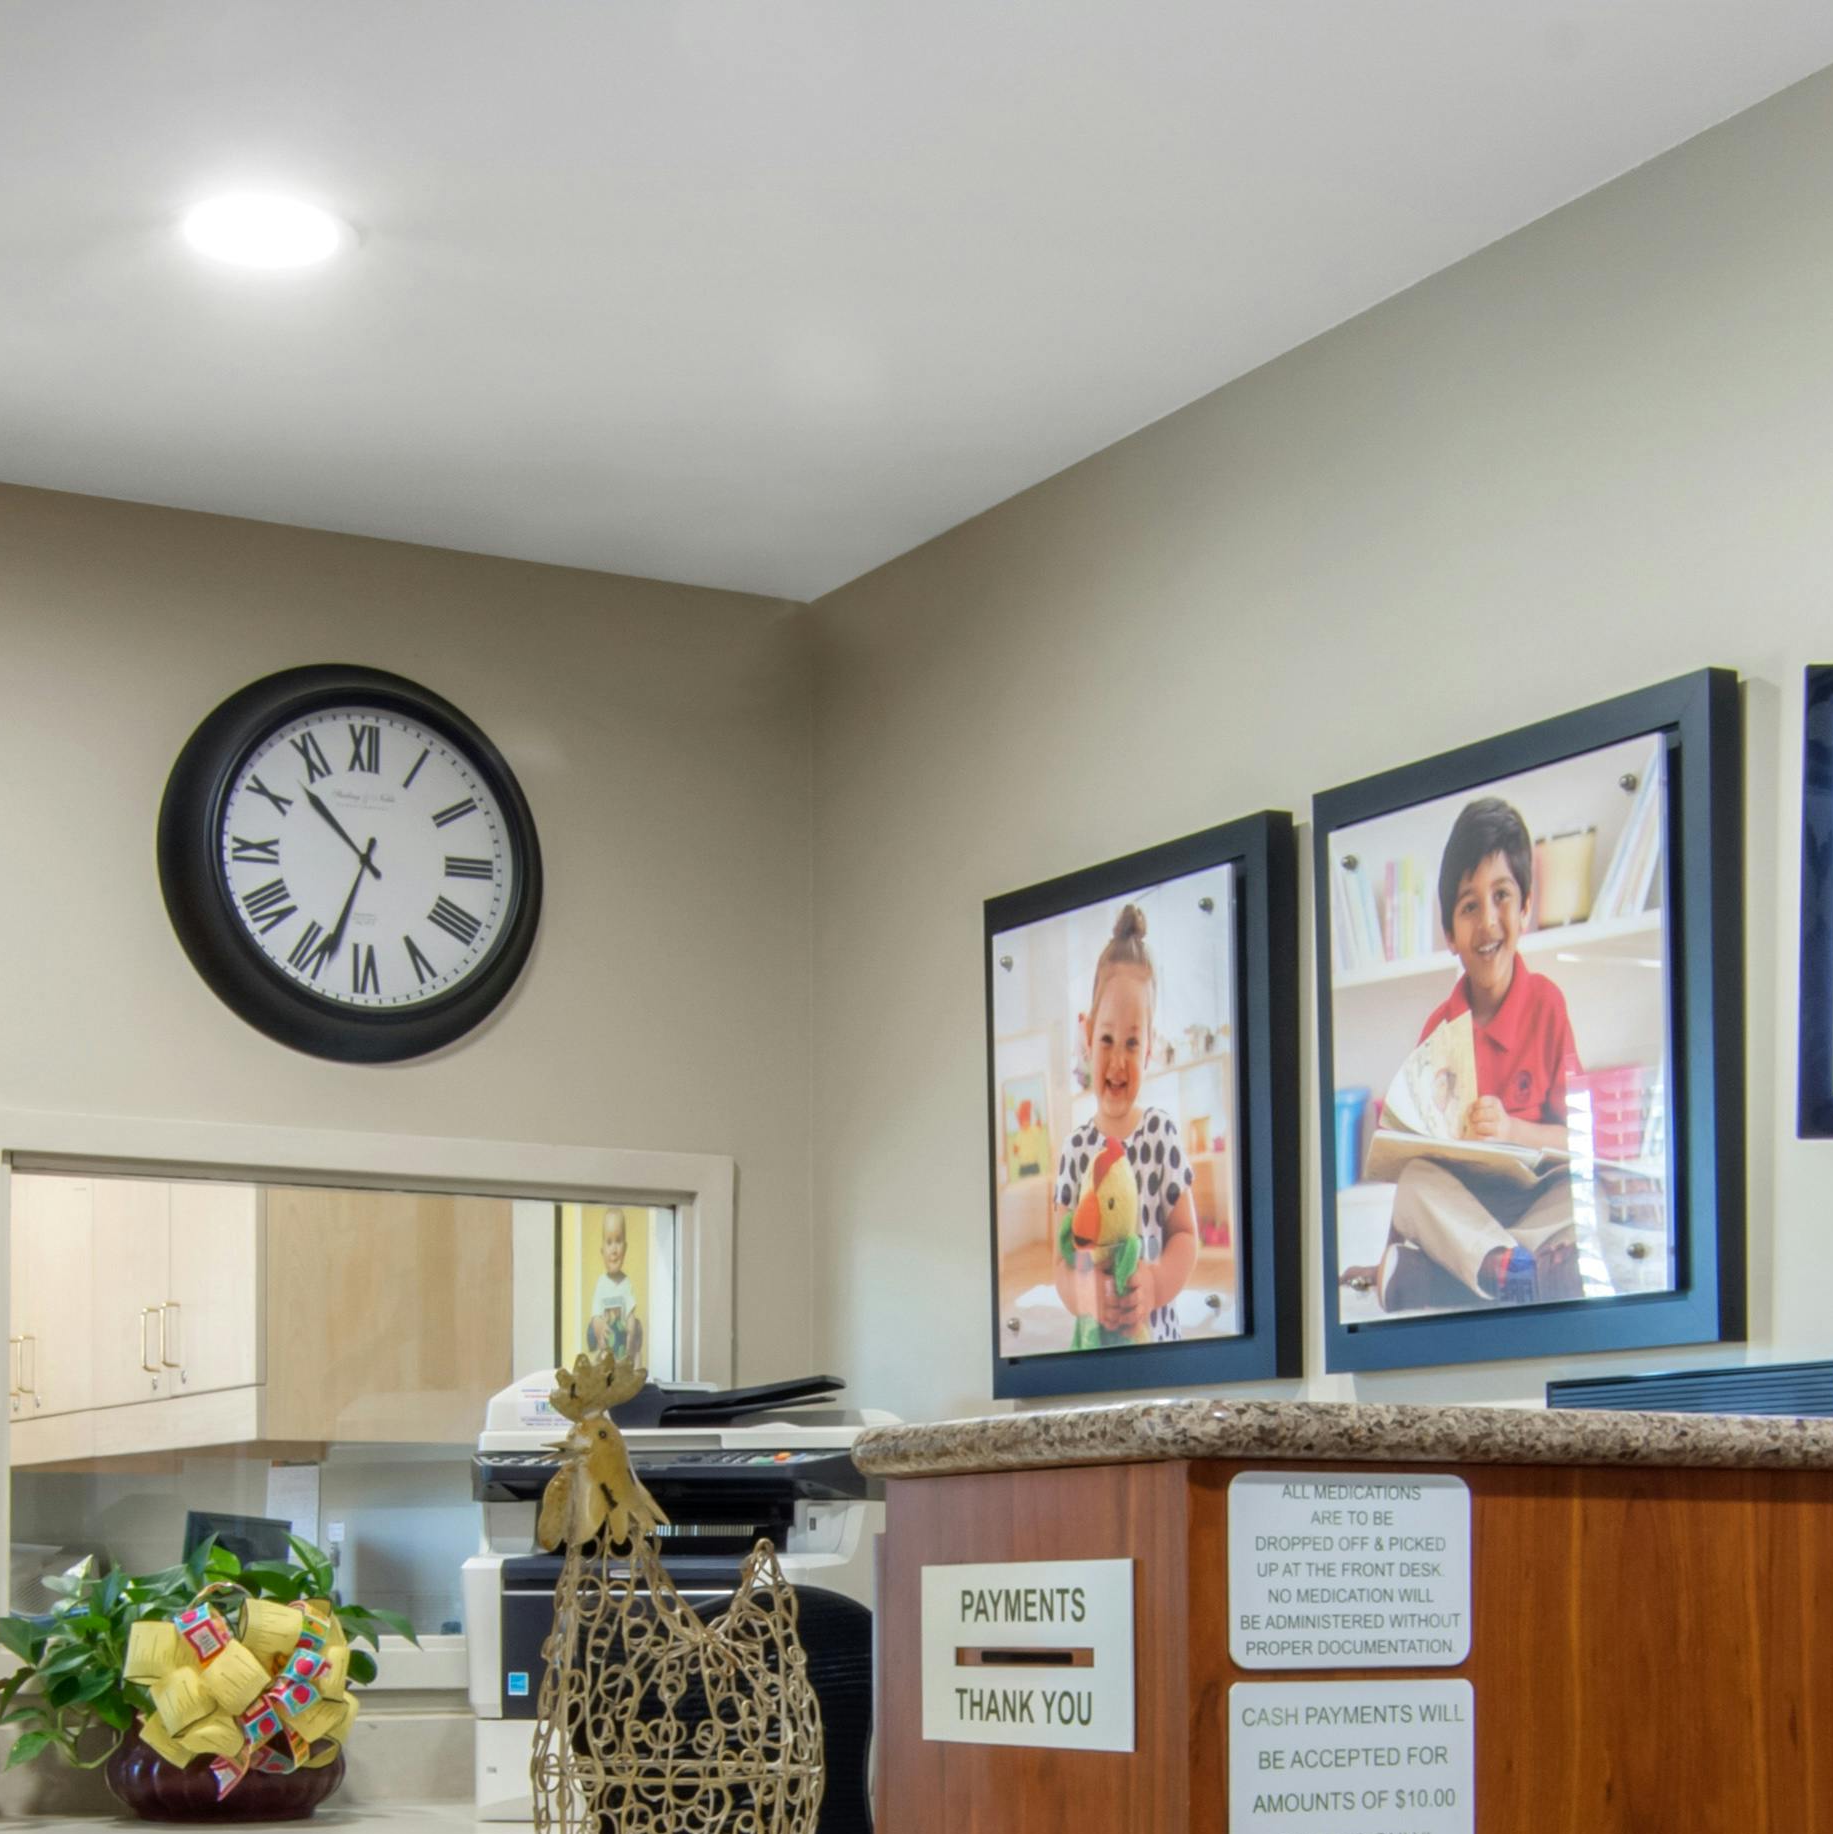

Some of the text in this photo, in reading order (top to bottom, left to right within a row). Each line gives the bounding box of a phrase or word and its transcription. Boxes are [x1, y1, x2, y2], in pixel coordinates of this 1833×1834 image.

[290, 731, 333, 785] XI
[347, 723, 380, 775] XII
[403, 748, 430, 789] I
[245, 774, 293, 817] X
[431, 796, 479, 829] II
[232, 836, 280, 865] IX
[445, 855, 493, 880] III
[241, 877, 299, 935] VIII
[427, 894, 483, 947] IIII
[352, 942, 380, 995] VI
[403, 934, 438, 985] V
[1282, 1484, 1421, 1500] ALL MEDICATIONS
[1311, 1511, 1393, 1525] ARE TO BE
[1255, 1536, 1446, 1552] DROPPED OFF & PICKED
[1256, 1562, 1278, 1578] UP
[1282, 1563, 1301, 1577] AT
[1307, 1563, 1336, 1577] THE
[1341, 1562, 1395, 1577] FRONT
[961, 1587, 1086, 1623] PAYMENTS
[1268, 1588, 1434, 1604] NO MEDICATION WILL
[1240, 1613, 1461, 1630] BE ADMINISTERED WITHOUT
[1246, 1641, 1313, 1655] PROPER
[955, 1688, 1092, 1726] THANK YOU
[1241, 1704, 1464, 1727] CASH PAYMENTS WILL
[1258, 1746, 1448, 1770] BE ACCEPTED FOR
[1253, 1788, 1455, 1813] AMOUNTS OF $10.00
